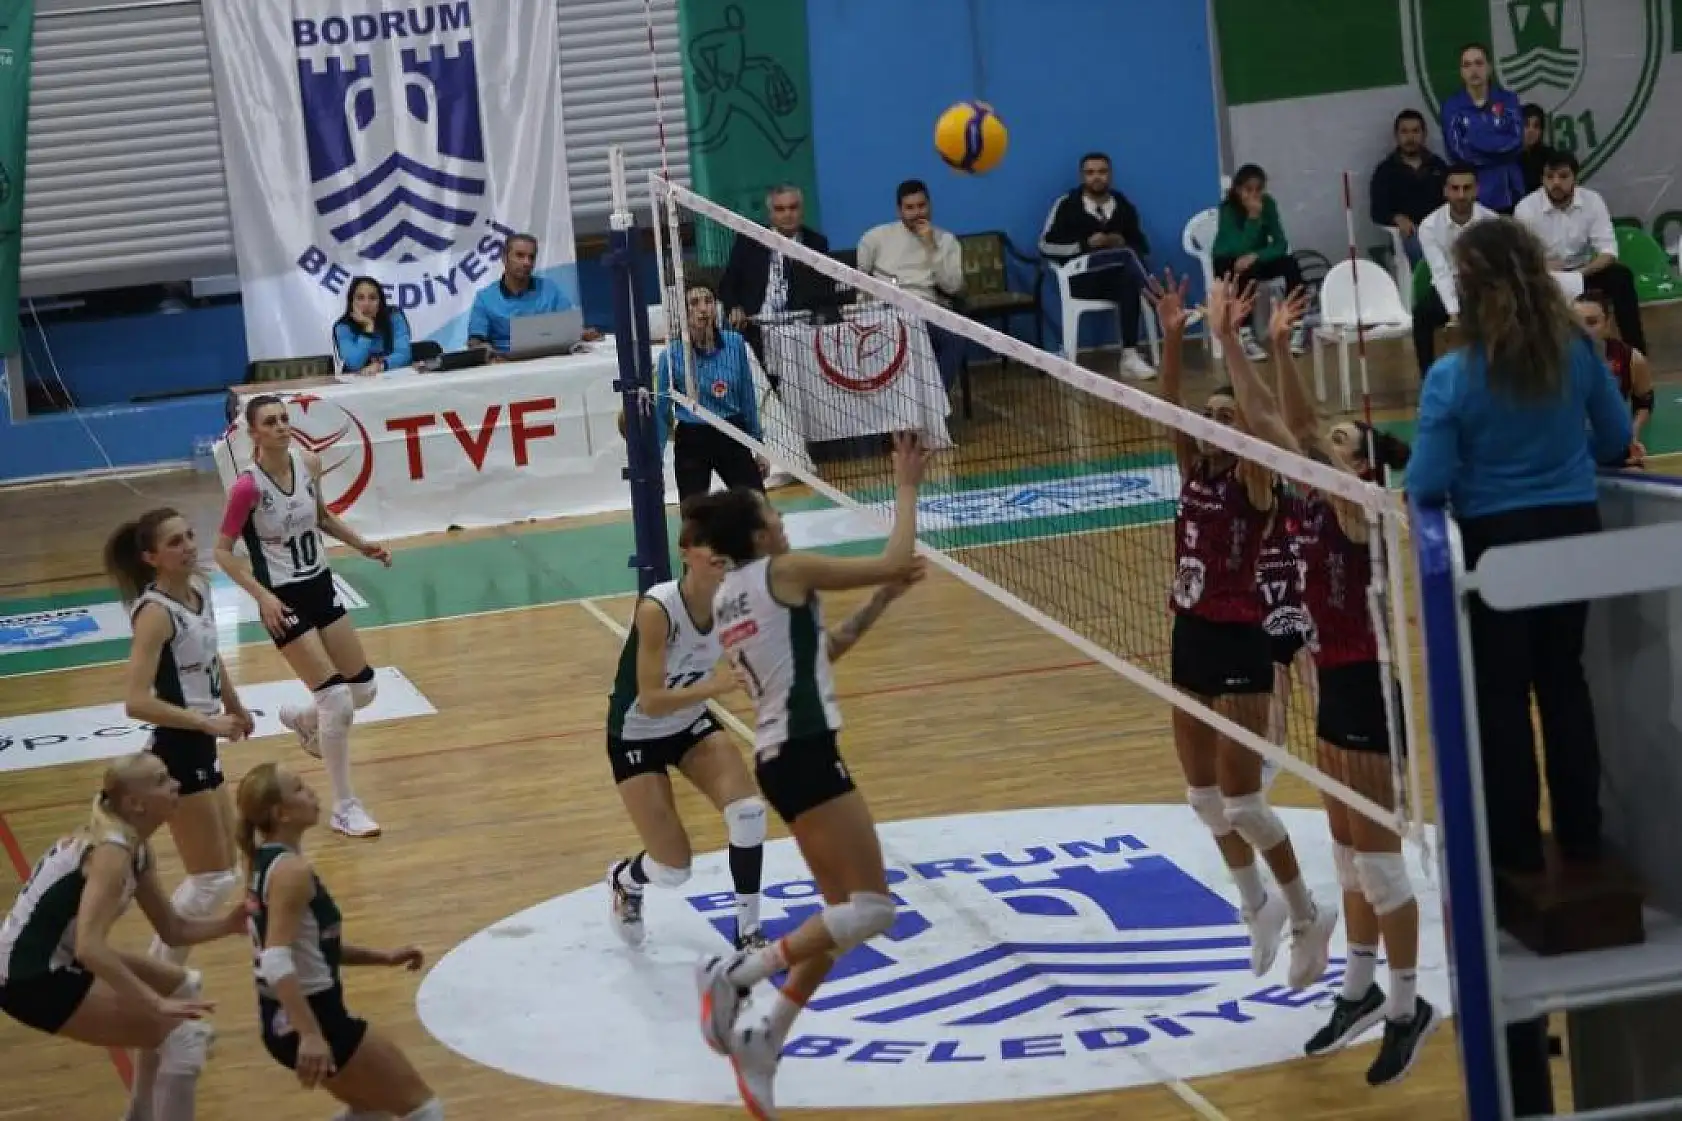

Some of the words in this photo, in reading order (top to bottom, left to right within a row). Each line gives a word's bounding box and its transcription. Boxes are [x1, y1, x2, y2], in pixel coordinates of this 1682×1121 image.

[292, 1, 472, 47] BODRUM
[384, 396, 557, 481] TVF
[283, 530, 318, 570] 10
[1259, 580, 1288, 605] 17
[625, 749, 642, 765] 17
[686, 833, 1149, 913] BORUM
